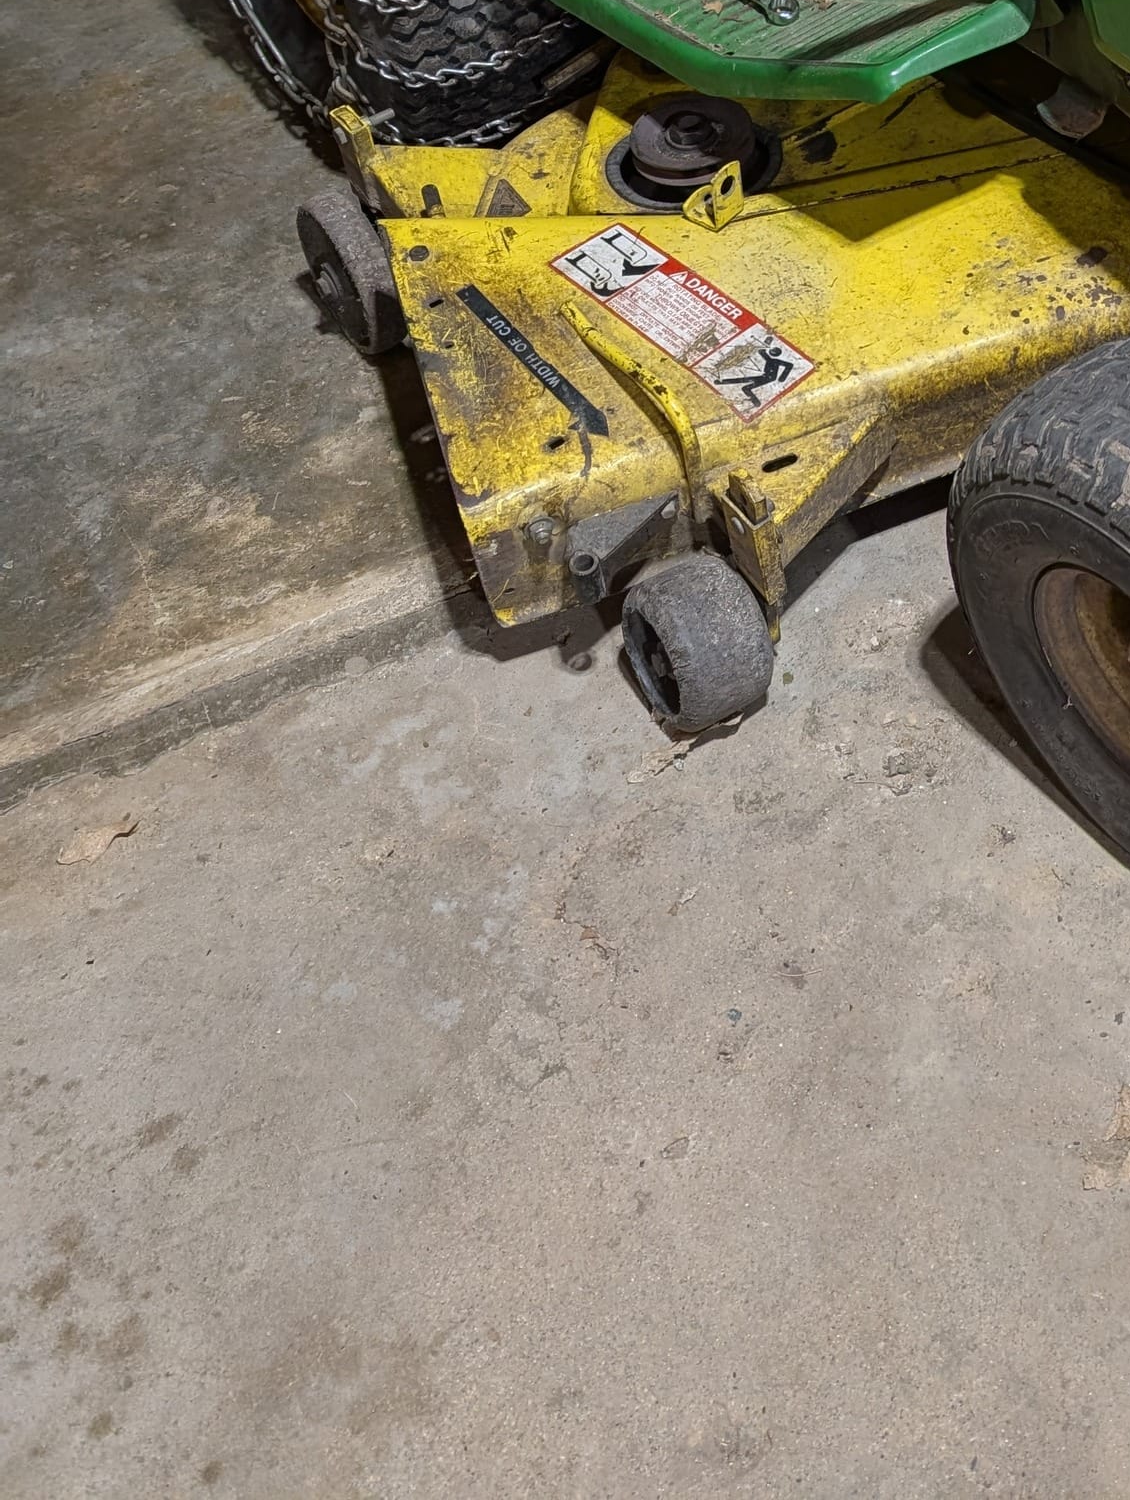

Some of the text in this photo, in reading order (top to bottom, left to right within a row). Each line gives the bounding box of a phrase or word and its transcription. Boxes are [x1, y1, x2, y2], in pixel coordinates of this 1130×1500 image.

[684, 277, 746, 319] DANGER
[486, 315, 560, 388] WIDTH OF CUT
